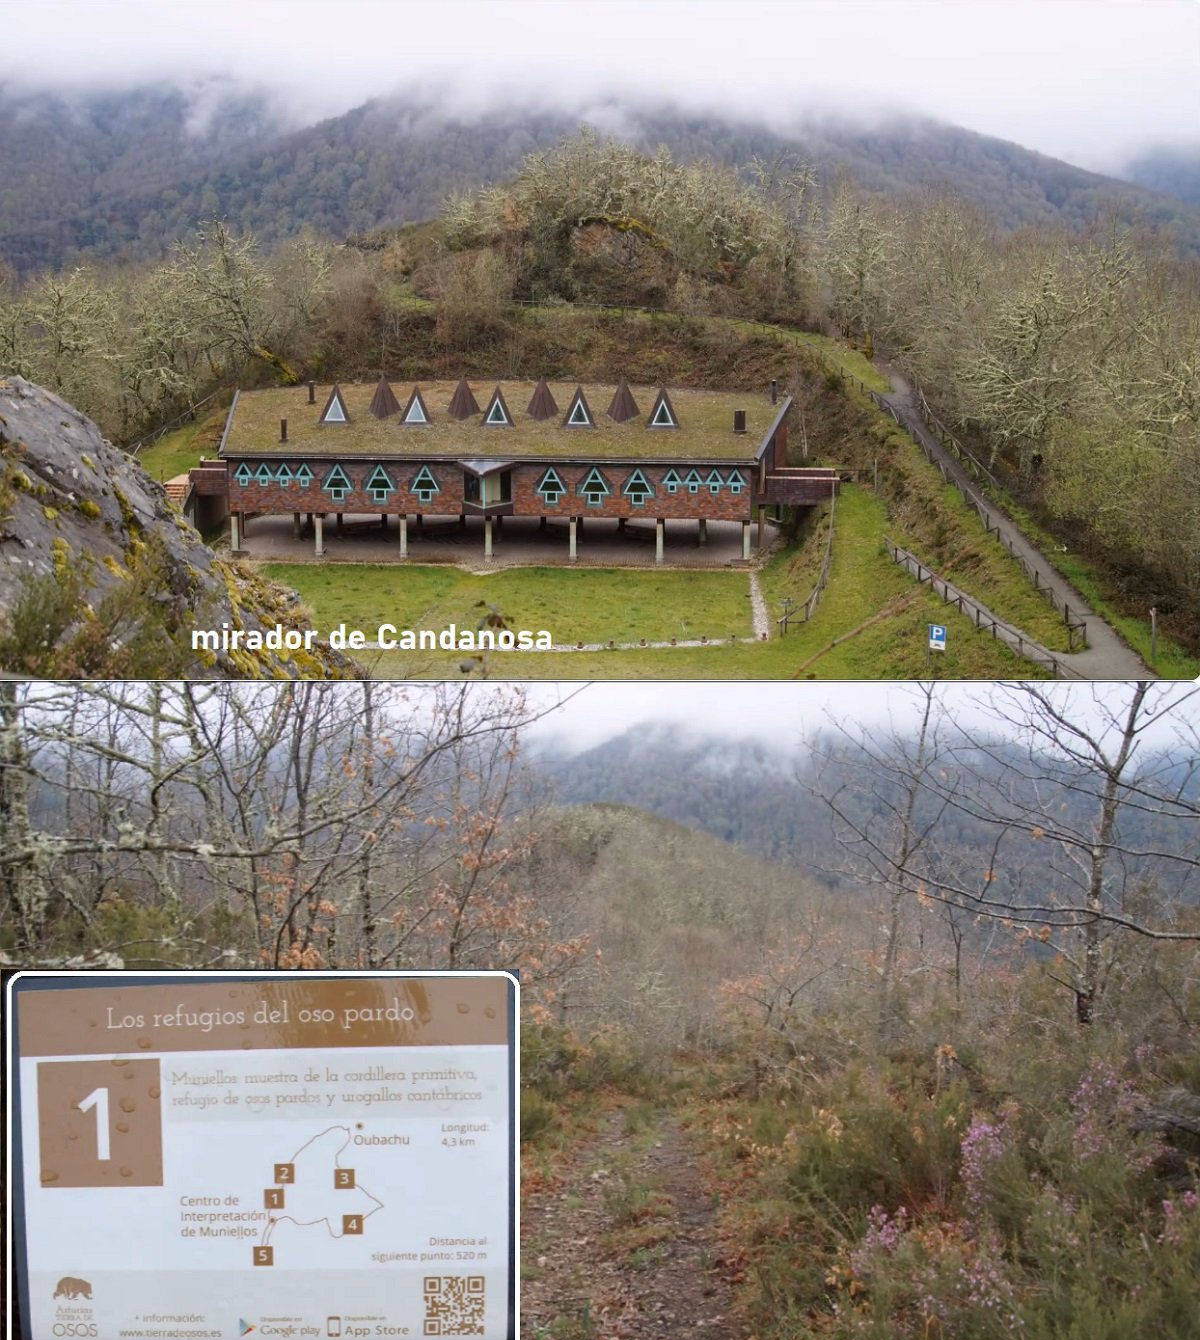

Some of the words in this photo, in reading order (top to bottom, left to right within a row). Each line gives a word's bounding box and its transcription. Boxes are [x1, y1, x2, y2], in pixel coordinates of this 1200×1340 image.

[932, 626, 943, 639] P
[106, 1007, 145, 1029] Los
[153, 1004, 246, 1032] refugios
[254, 1000, 289, 1024] del
[298, 1007, 335, 1023] oso
[343, 997, 415, 1029] pardo
[244, 1072, 298, 1084] muestra
[304, 1067, 320, 1082] de
[326, 1067, 338, 1082] la
[344, 1066, 406, 1082] cordillera
[412, 1068, 478, 1084] primitiva,
[172, 1091, 218, 1109] refugio
[223, 1090, 239, 1104] de
[245, 1094, 271, 1104] osos
[276, 1088, 321, 1107] pardos
[326, 1094, 336, 1106] y
[341, 1087, 402, 1105] urogallos
[407, 1086, 482, 1101] cantábricos
[78, 1087, 110, 1161] 1
[441, 1123, 489, 1134] Longitud:
[353, 1134, 410, 1145] Oubachu
[441, 1138, 457, 1147] 4,3
[459, 1137, 476, 1147] km
[279, 1167, 289, 1180] 2
[339, 1173, 349, 1185] 3
[180, 1195, 221, 1207] Centro
[224, 1196, 240, 1206] de
[271, 1193, 279, 1205] 1
[180, 1210, 266, 1224] Interpretación
[348, 1218, 358, 1231] 4
[180, 1227, 196, 1238] de
[429, 1237, 476, 1246] Distancia
[478, 1236, 487, 1246] al
[258, 1250, 268, 1262] 5
[371, 1251, 418, 1263] siguiente
[420, 1251, 454, 1262] punto:
[456, 1251, 476, 1260] 520
[55, 1306, 93, 1314] Asturias
[142, 1313, 205, 1323] información:
[52, 1323, 98, 1337] OSOS
[119, 1328, 222, 1338] www.tierradeosos.es
[260, 1325, 298, 1337] Google
[300, 1326, 321, 1336] play
[344, 1326, 371, 1336] App
[375, 1325, 410, 1335] Store
